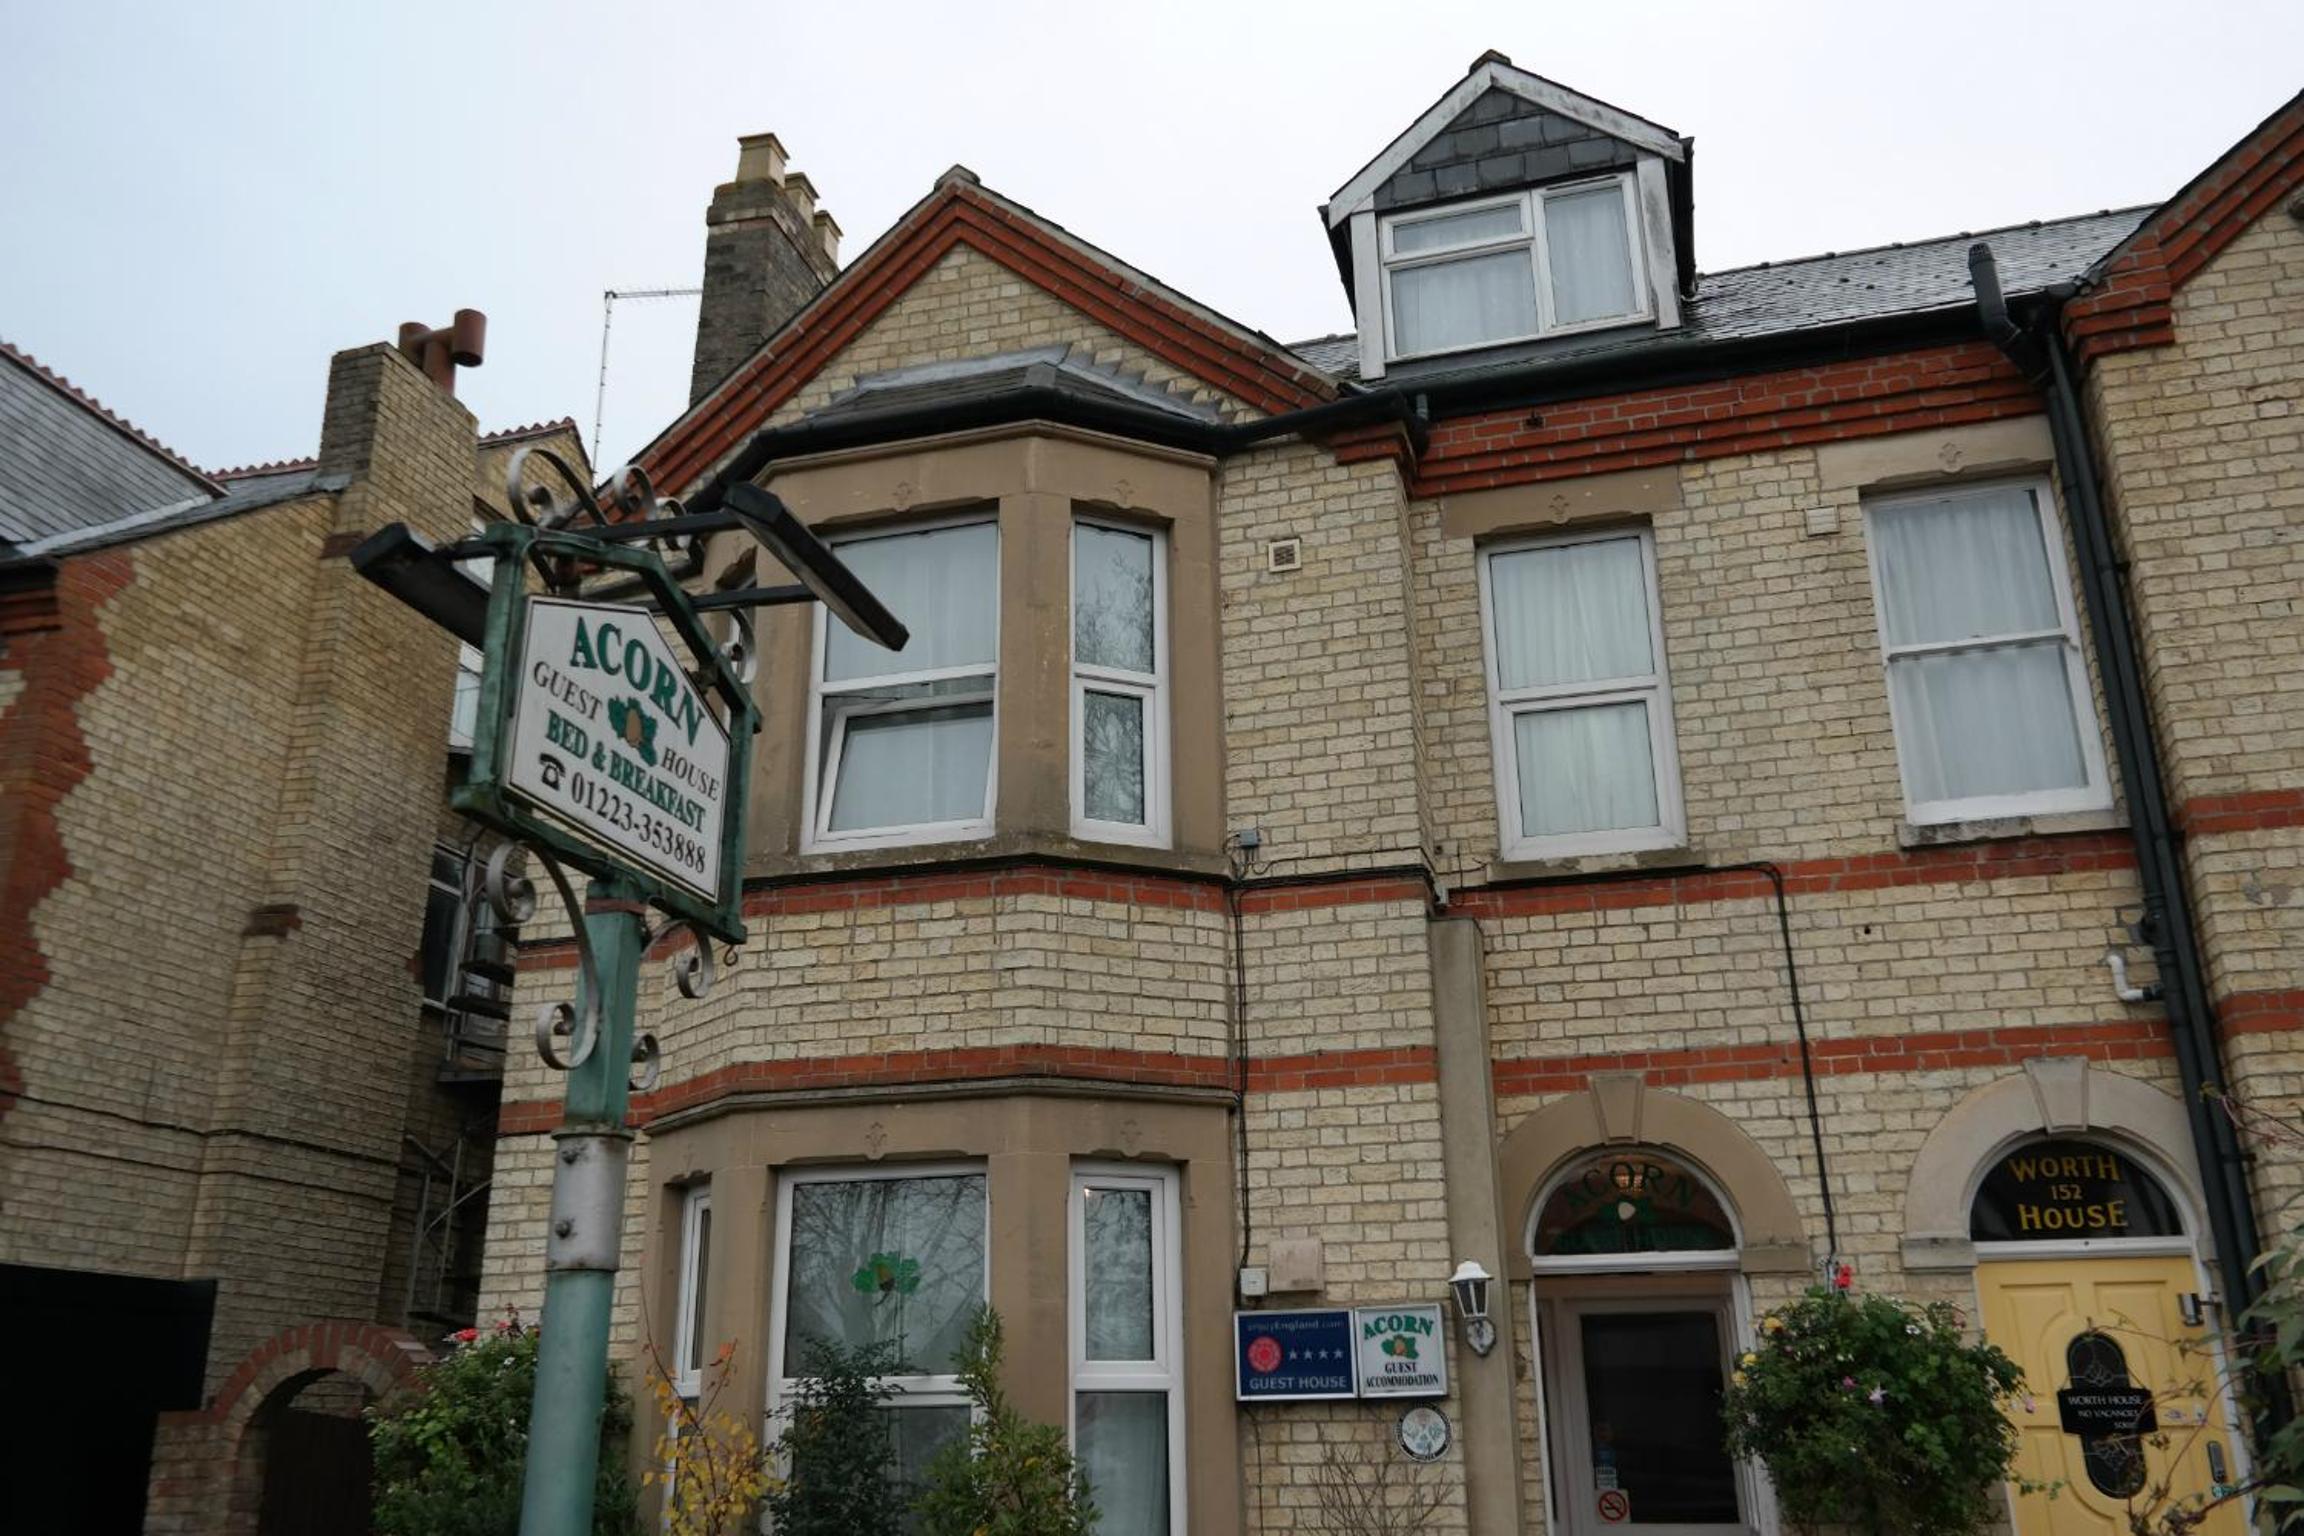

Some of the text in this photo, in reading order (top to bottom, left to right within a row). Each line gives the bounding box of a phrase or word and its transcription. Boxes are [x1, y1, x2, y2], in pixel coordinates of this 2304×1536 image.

[570, 616, 705, 747] ACORN
[533, 661, 719, 801] GUEST HOUSE
[545, 709, 706, 834] BED & BREAKFAST
[572, 771, 706, 875] 01223-353888
[2008, 1154, 2121, 1182] WORTH
[2050, 1184, 2083, 1200] 152
[2018, 1201, 2128, 1231] HOUSE
[1364, 1314, 1434, 1340] ACORN
[1366, 1373, 1439, 1388] ACCOMMODATION
[1385, 1361, 1416, 1374] GUEST
[1249, 1374, 1347, 1390] GUEST HOUSE
[2067, 1395, 2106, 1406] WORTH
